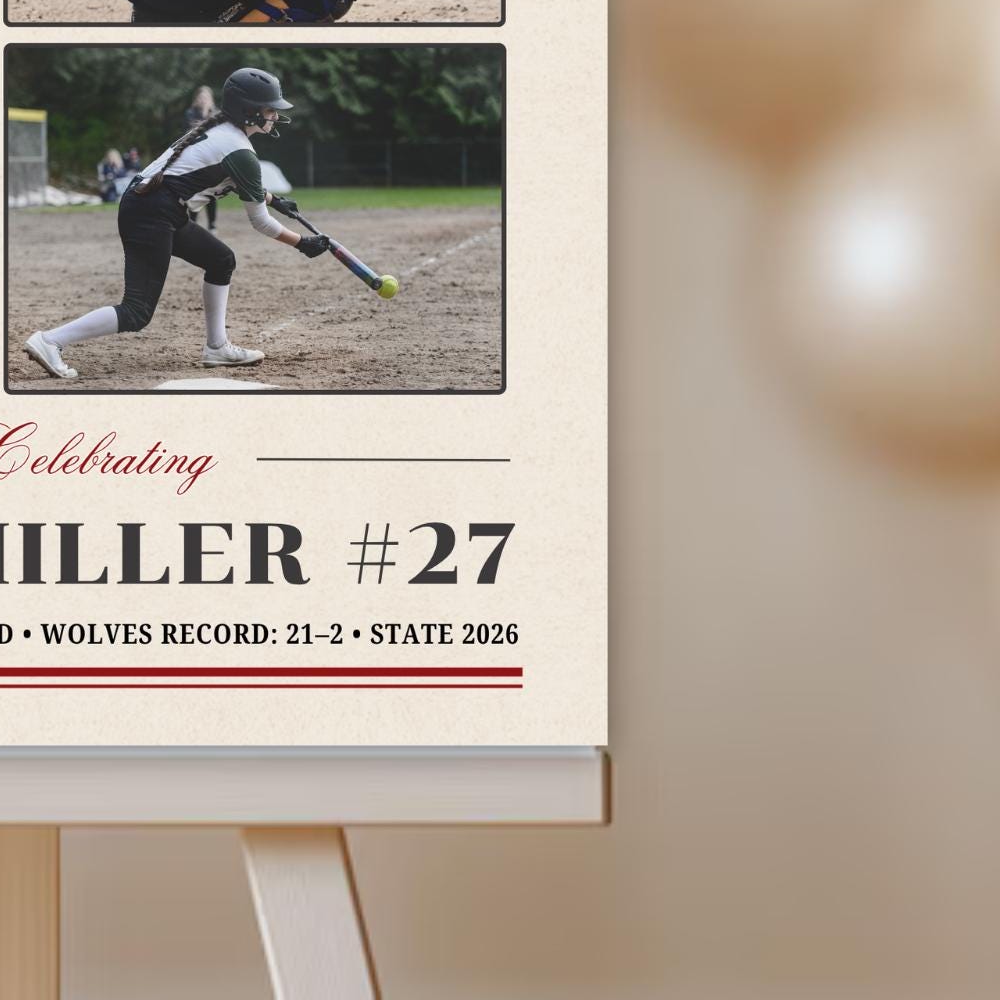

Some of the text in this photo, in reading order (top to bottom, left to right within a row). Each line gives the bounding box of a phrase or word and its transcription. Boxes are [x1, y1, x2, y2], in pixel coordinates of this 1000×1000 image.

[347, 522, 516, 585] #27
[39, 622, 153, 645] WOLVES
[160, 622, 277, 645] RECORD:
[286, 622, 344, 645] 21–2
[370, 622, 454, 645] STATE
[462, 622, 519, 645] 2026
